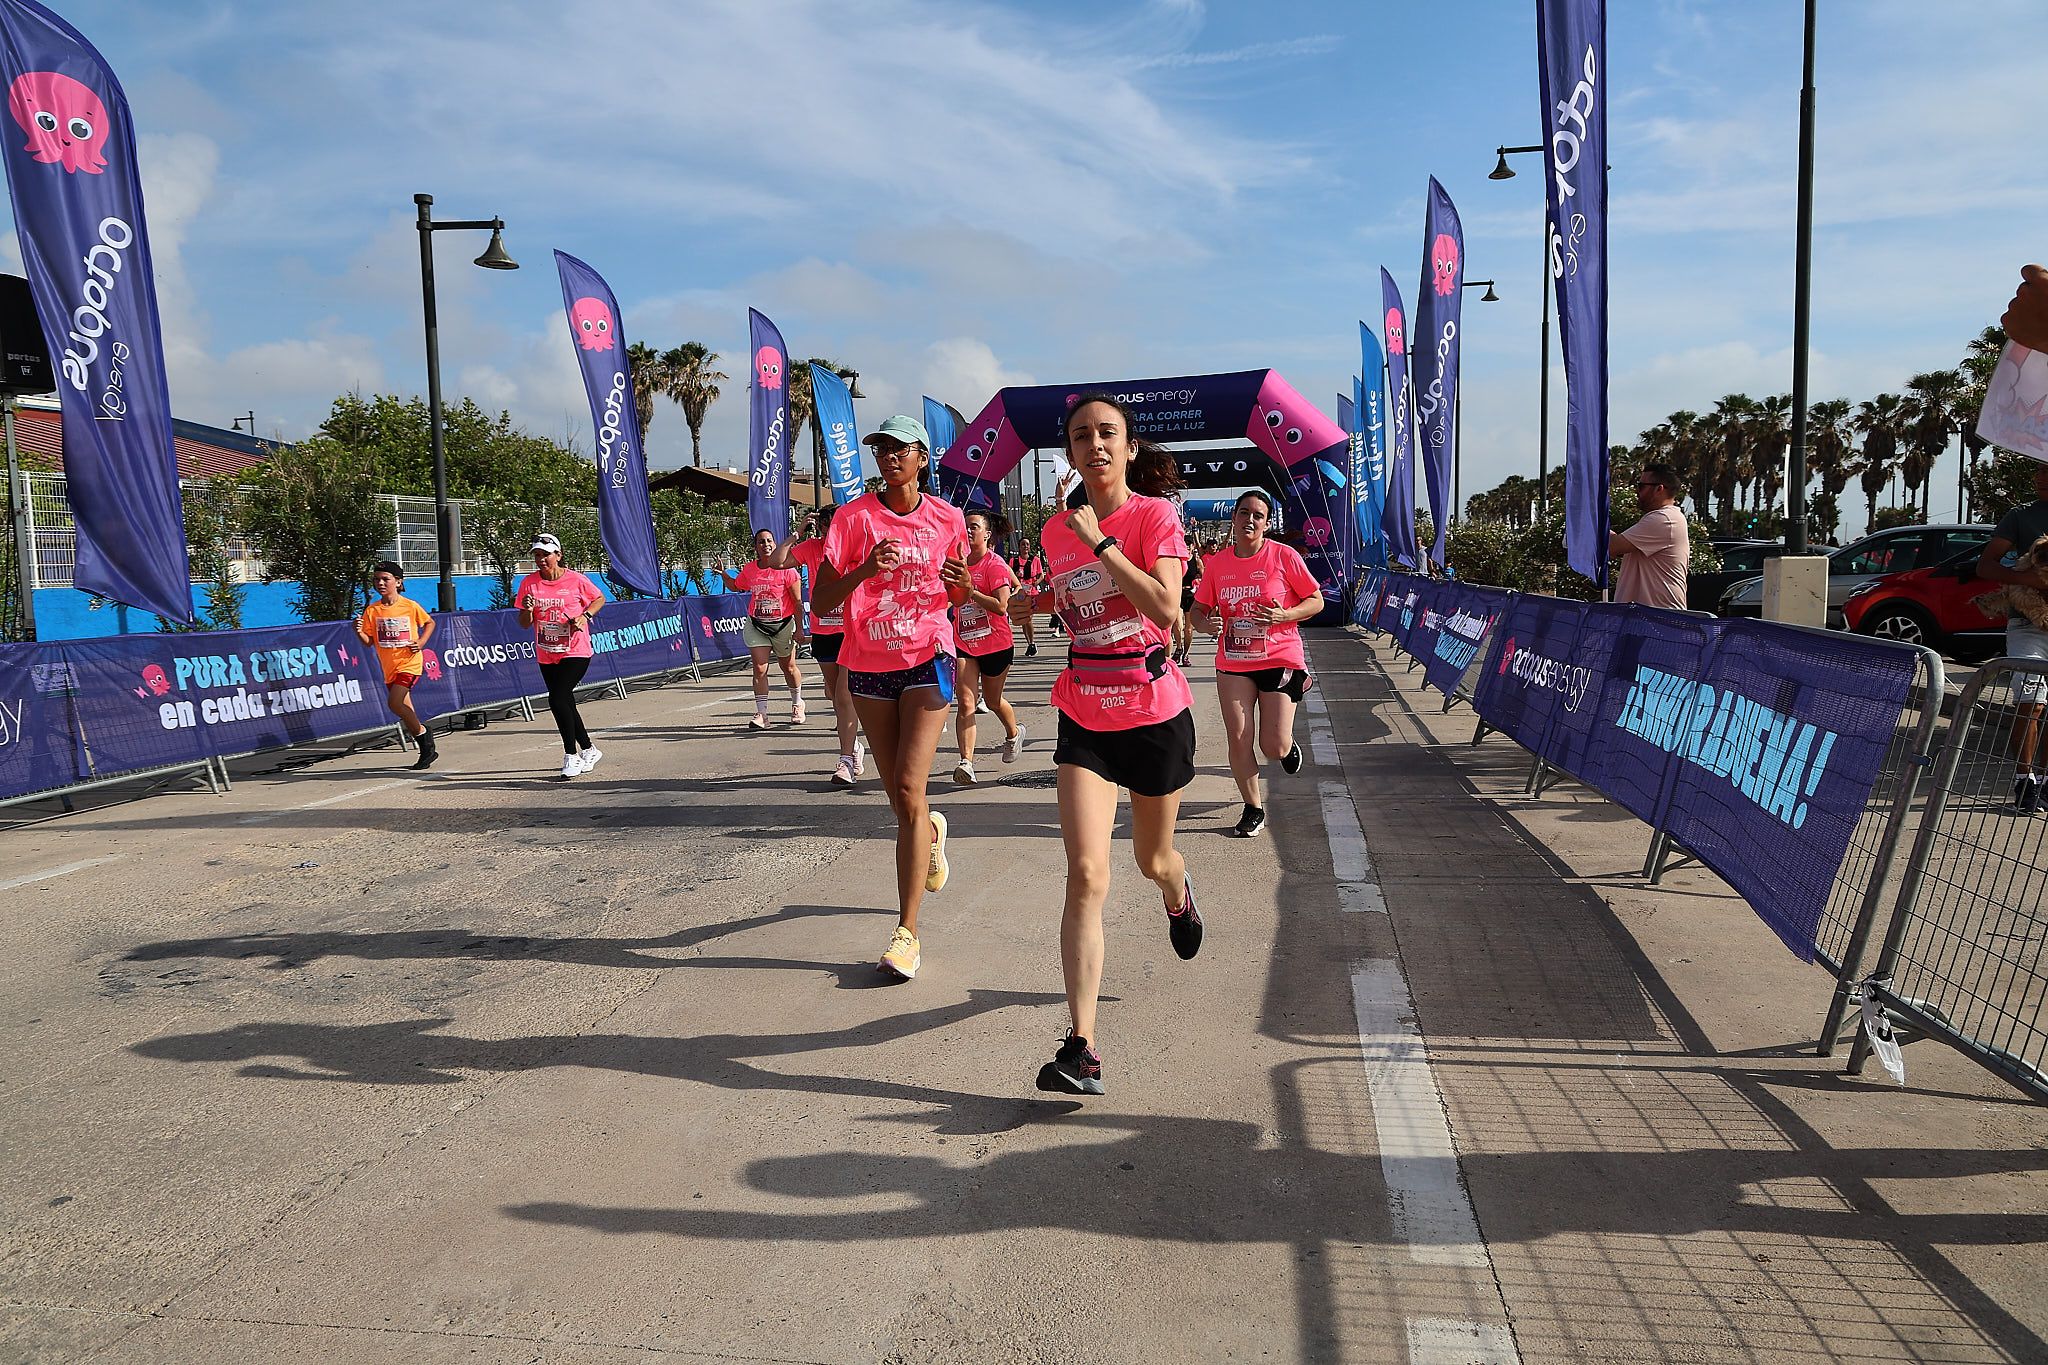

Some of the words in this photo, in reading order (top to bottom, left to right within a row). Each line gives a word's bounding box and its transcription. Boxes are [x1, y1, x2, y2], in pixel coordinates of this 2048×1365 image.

[1146, 389, 1197, 405] energy
[1132, 413, 1154, 421] ARA
[1157, 409, 1202, 420] CORRER
[1184, 421, 1205, 430] LUZ
[1182, 460, 1248, 474] LVO
[900, 569, 921, 592] DE
[1220, 585, 1261, 600] CARRERA
[1080, 600, 1106, 619] 016
[867, 619, 916, 641] MUJER
[963, 618, 977, 627] 016
[591, 630, 619, 654] ORRE
[617, 624, 645, 649] COMO
[643, 620, 660, 642] UN
[886, 640, 904, 651] 2026
[1234, 636, 1251, 646] 016
[505, 641, 537, 660] ener
[173, 654, 247, 691] PURA
[250, 644, 333, 683] CHISPA
[1512, 646, 1552, 689] octopus
[158, 700, 196, 730] en
[200, 688, 266, 724] cada
[267, 674, 363, 716] zancada
[1100, 695, 1126, 709] 2026
[1615, 664, 1838, 830] ¡ENHORABUENA!
